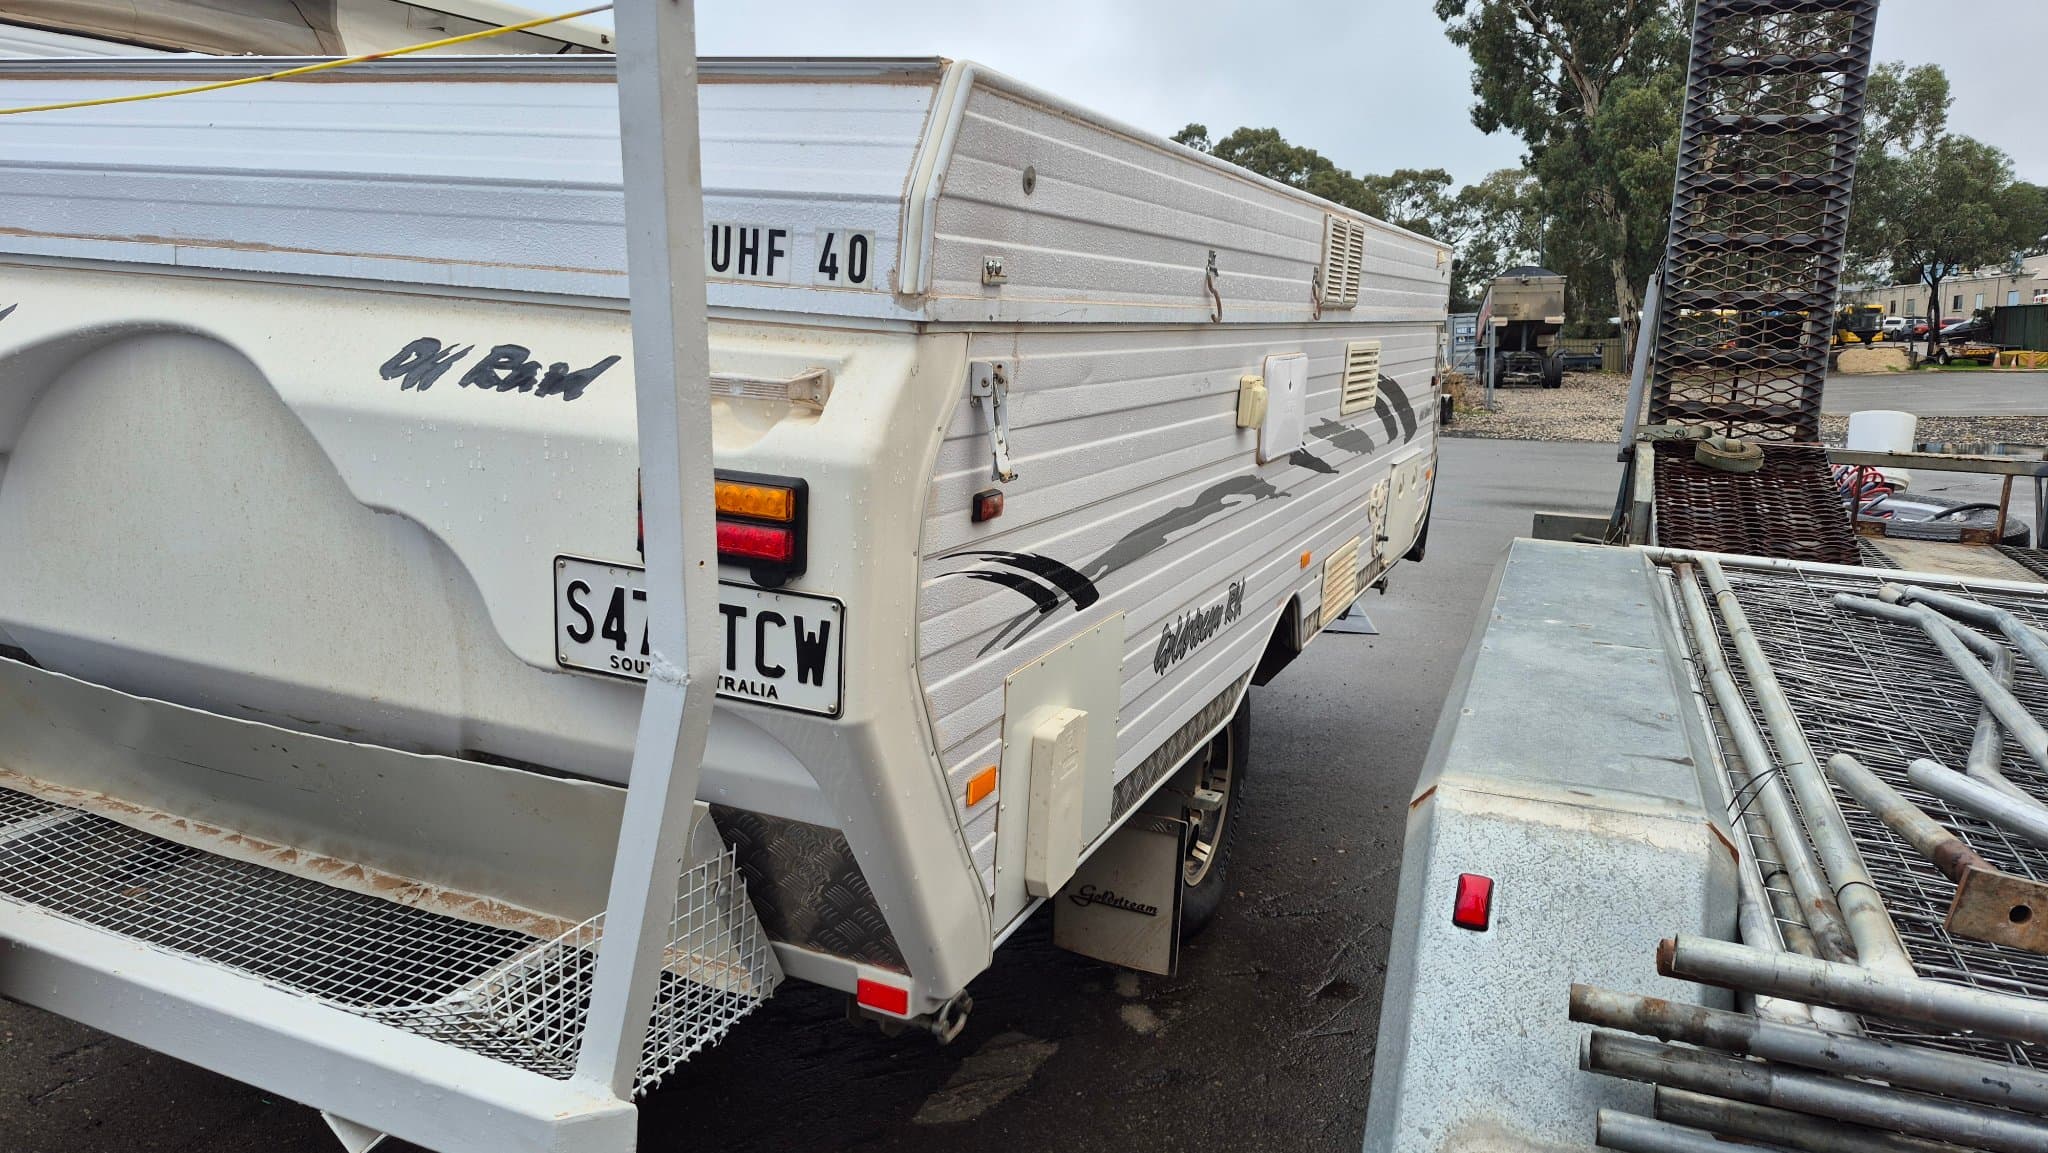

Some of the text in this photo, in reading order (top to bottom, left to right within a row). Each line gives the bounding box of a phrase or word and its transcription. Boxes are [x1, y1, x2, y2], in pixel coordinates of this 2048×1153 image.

[711, 224, 868, 284] UHF 40
[610, 654, 778, 700] SOU TRALIA
[1068, 884, 1158, 917] Goldstream
